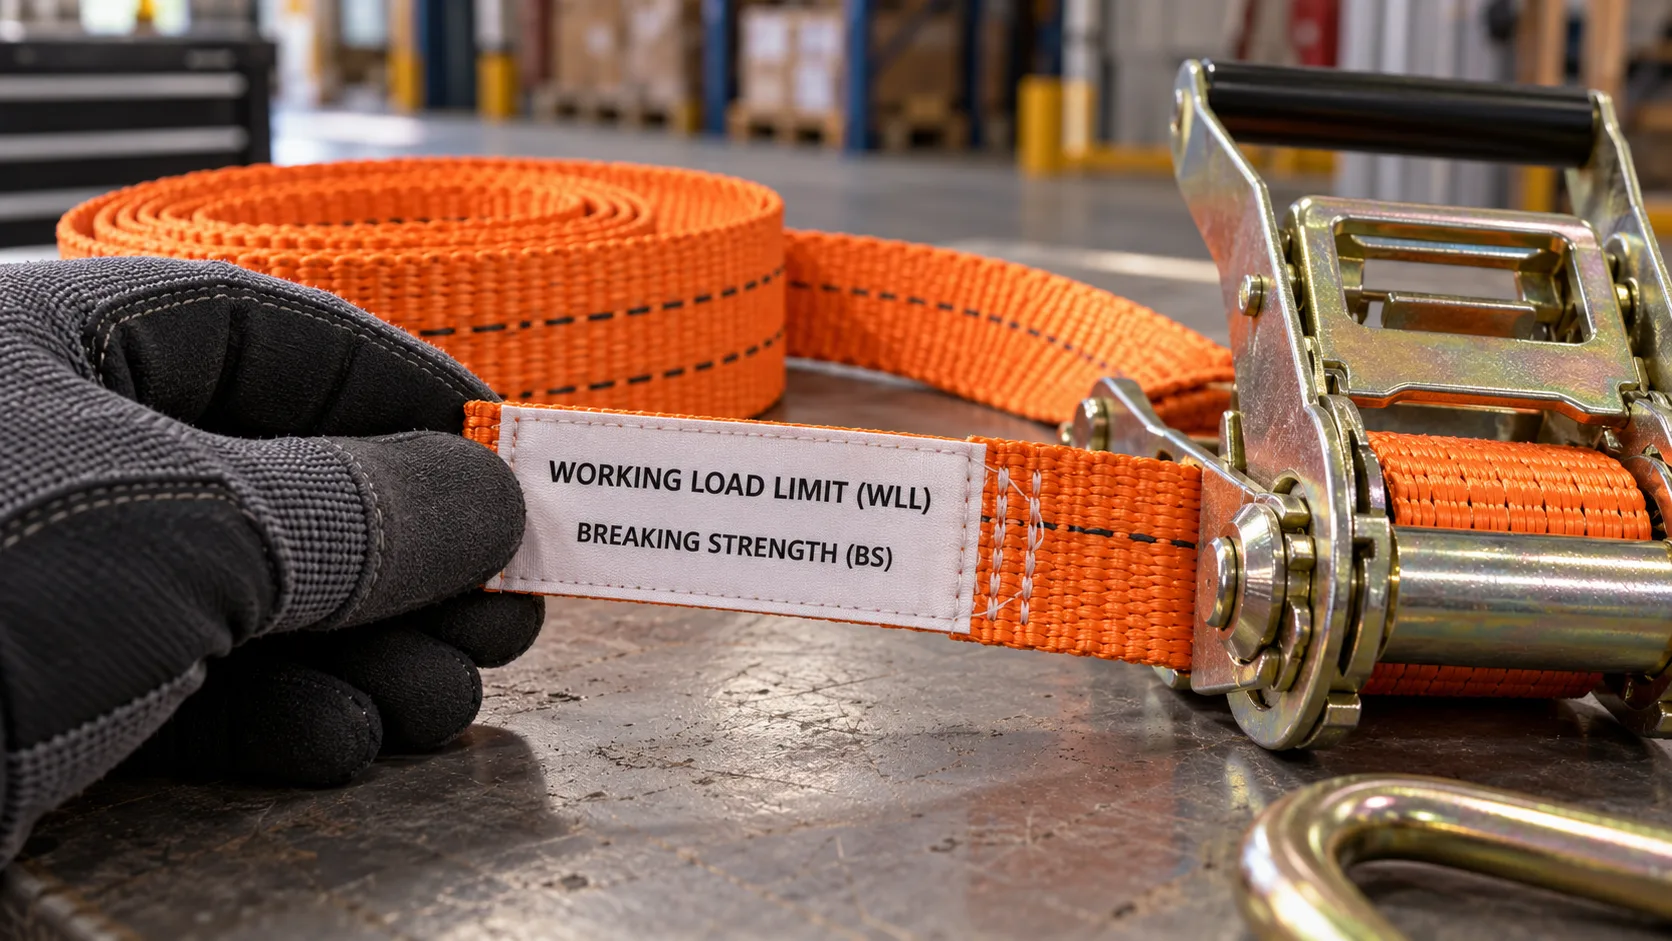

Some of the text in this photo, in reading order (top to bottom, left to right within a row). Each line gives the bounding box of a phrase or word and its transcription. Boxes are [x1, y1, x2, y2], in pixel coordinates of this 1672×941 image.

[548, 460, 931, 515] WORKING LOAD LIMIT (WLL)
[577, 522, 893, 573] BREAKING STRENGTH (BS)
